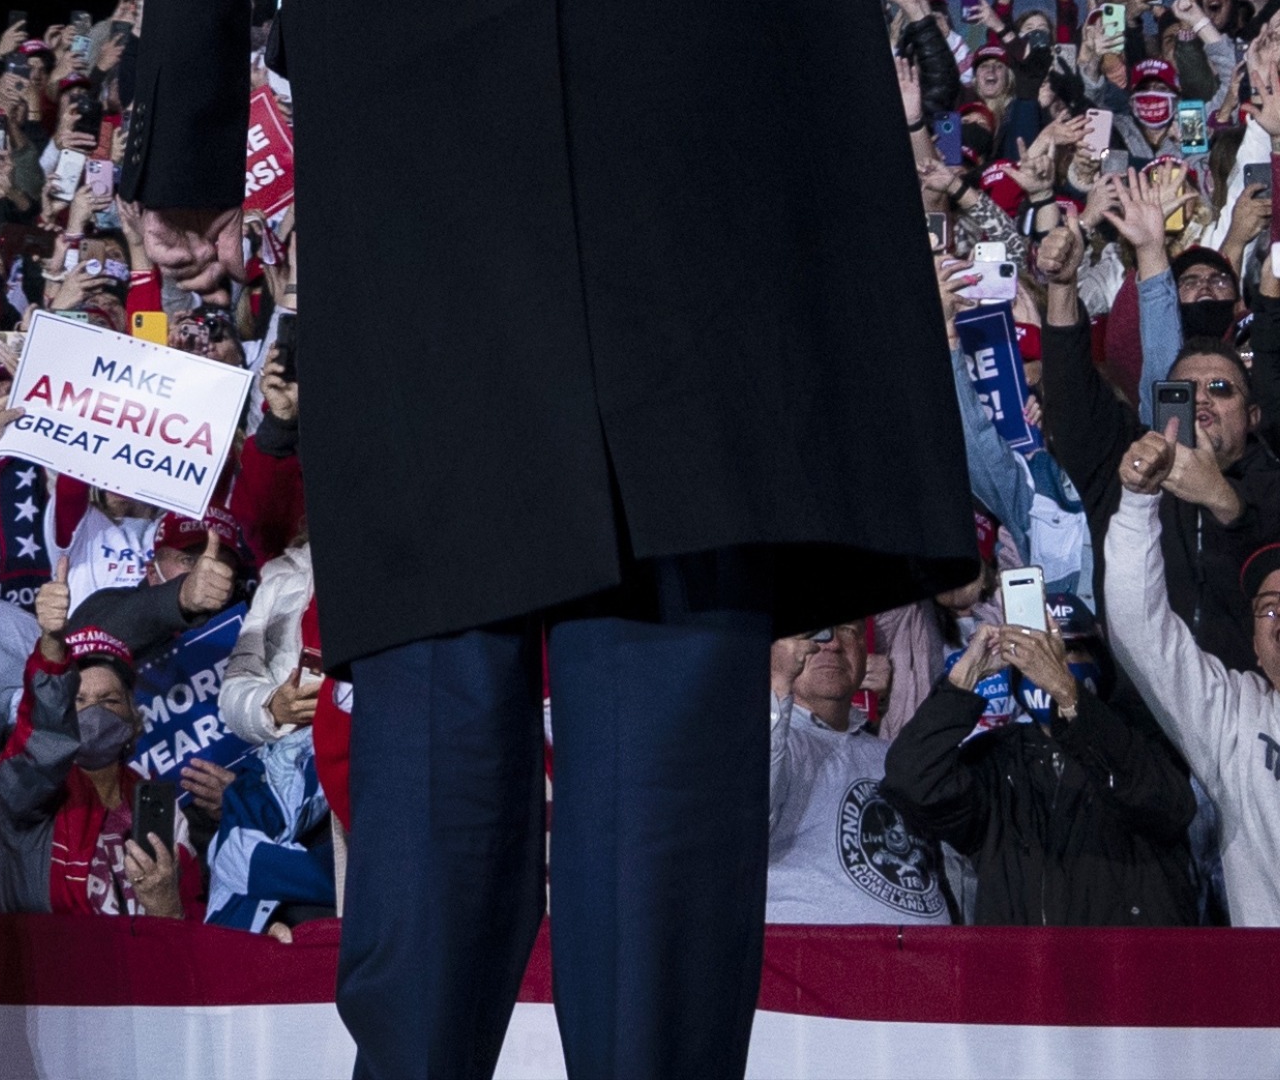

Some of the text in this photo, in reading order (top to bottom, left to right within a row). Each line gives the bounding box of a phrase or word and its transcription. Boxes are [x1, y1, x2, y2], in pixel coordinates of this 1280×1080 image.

[91, 355, 177, 400] MAKE
[23, 373, 215, 457] AMERICA
[14, 413, 208, 486] GREAT AGAIN
[128, 714, 233, 781] YEAR
[842, 801, 861, 851] 2ND
[848, 863, 925, 912] HOMELAND
